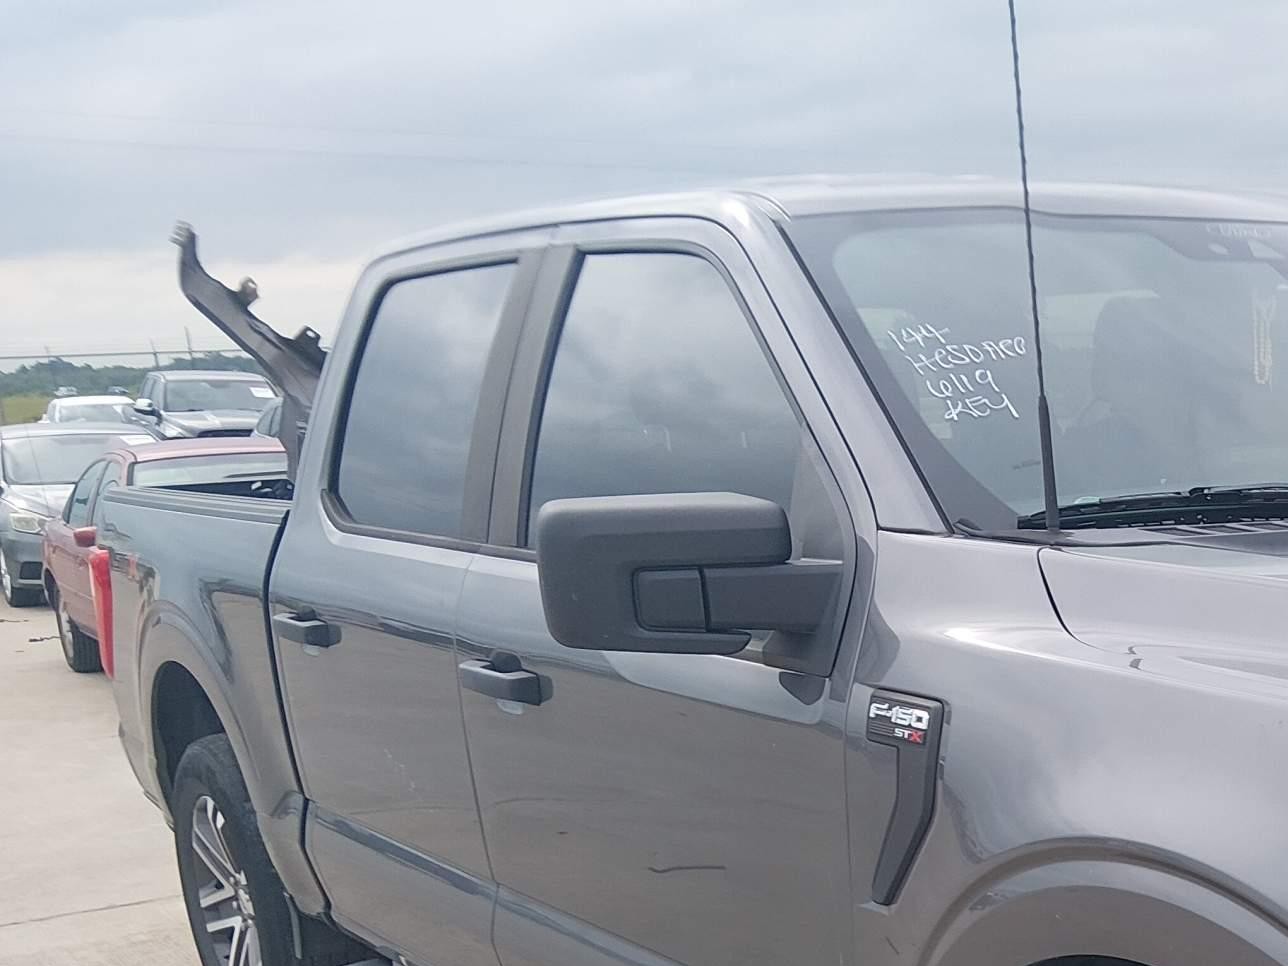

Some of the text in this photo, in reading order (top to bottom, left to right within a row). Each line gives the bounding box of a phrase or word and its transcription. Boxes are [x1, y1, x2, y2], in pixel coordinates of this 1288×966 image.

[887, 323, 950, 351] 144
[944, 393, 1020, 420] KEY
[869, 703, 930, 730] F-150
[894, 728, 925, 743] STX
